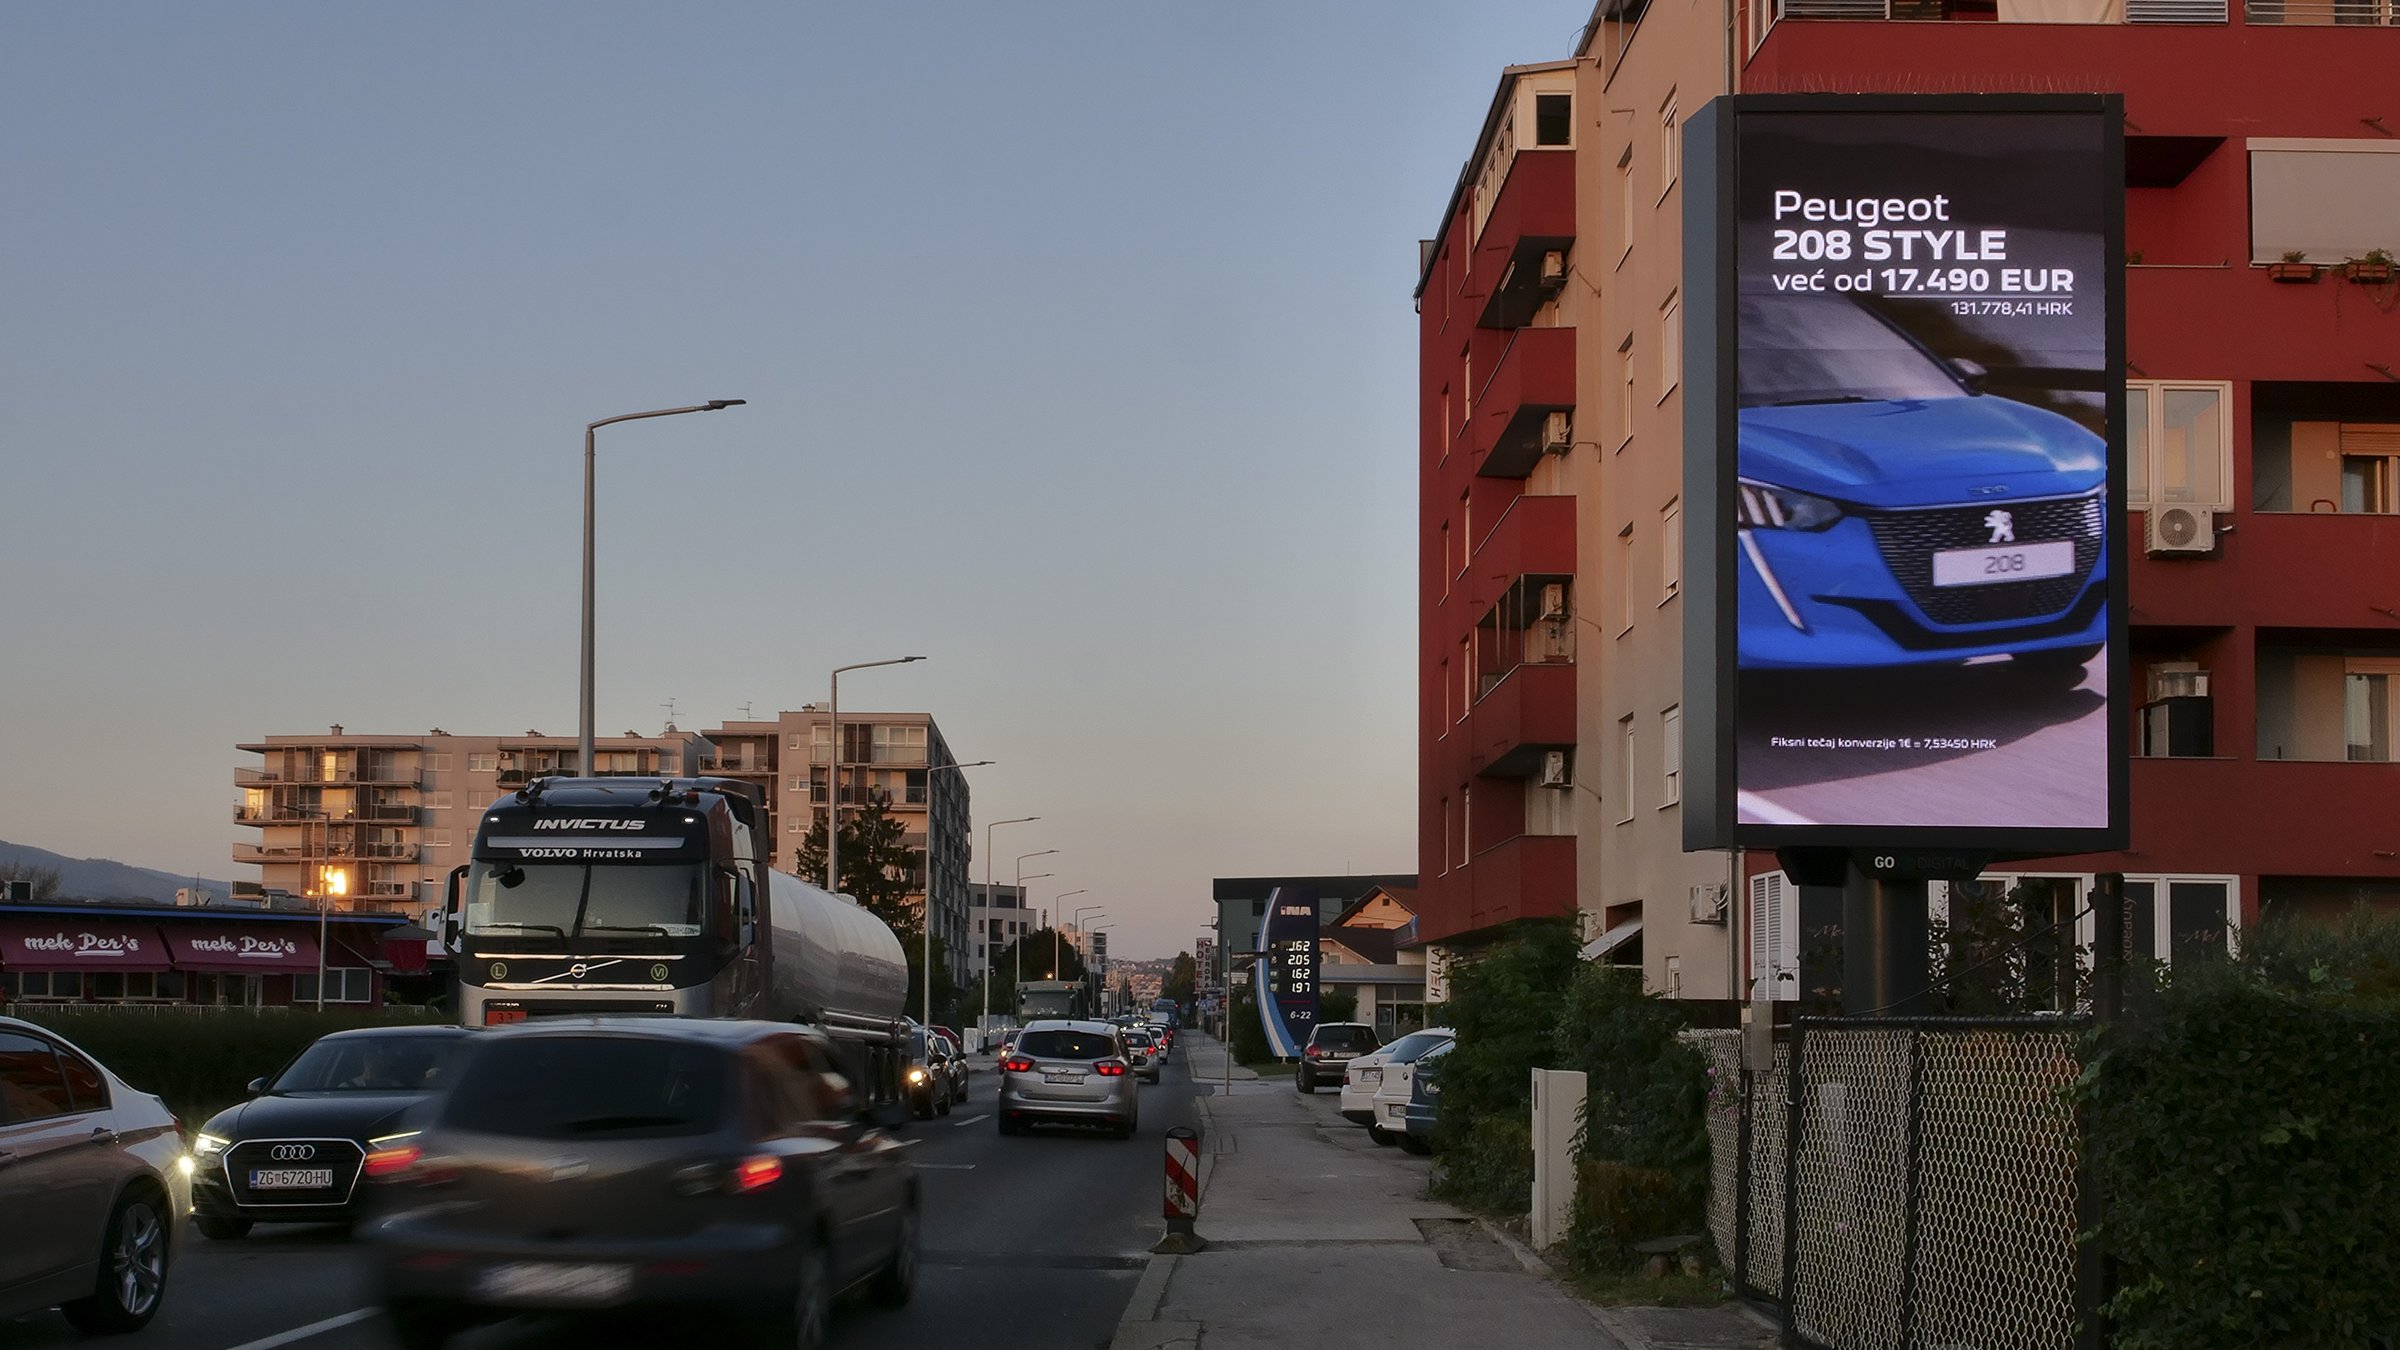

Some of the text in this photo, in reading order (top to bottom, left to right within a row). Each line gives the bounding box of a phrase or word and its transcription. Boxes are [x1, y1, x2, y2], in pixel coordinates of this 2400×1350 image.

[1774, 190, 1950, 228] Peugeot
[1772, 229, 2007, 261] 208 STYLE
[1772, 268, 2075, 292] već od 17.490 EUR
[1951, 301, 2073, 317] 131.778,41 HRK
[1985, 554, 2024, 574] 208
[1770, 737, 1805, 747] Fiksni
[1807, 737, 1835, 750] tečaj
[1838, 737, 1896, 750] konverzije
[1898, 739, 1911, 748] 1€
[1923, 739, 1968, 750] 7,53450
[1970, 740, 1997, 749] HRK
[533, 818, 646, 831] INVICTUS
[519, 848, 642, 859] VOLVO Hrvatska
[1874, 855, 1896, 869] GO
[24, 932, 140, 951] mek Per's
[191, 935, 297, 954] mek Per's
[495, 966, 503, 977] L
[1196, 940, 1205, 989] HOTEL
[1431, 947, 1442, 998] HELLA
[1290, 1011, 1312, 1019] 6-22
[259, 1171, 331, 1185] ZG 6720-HU
